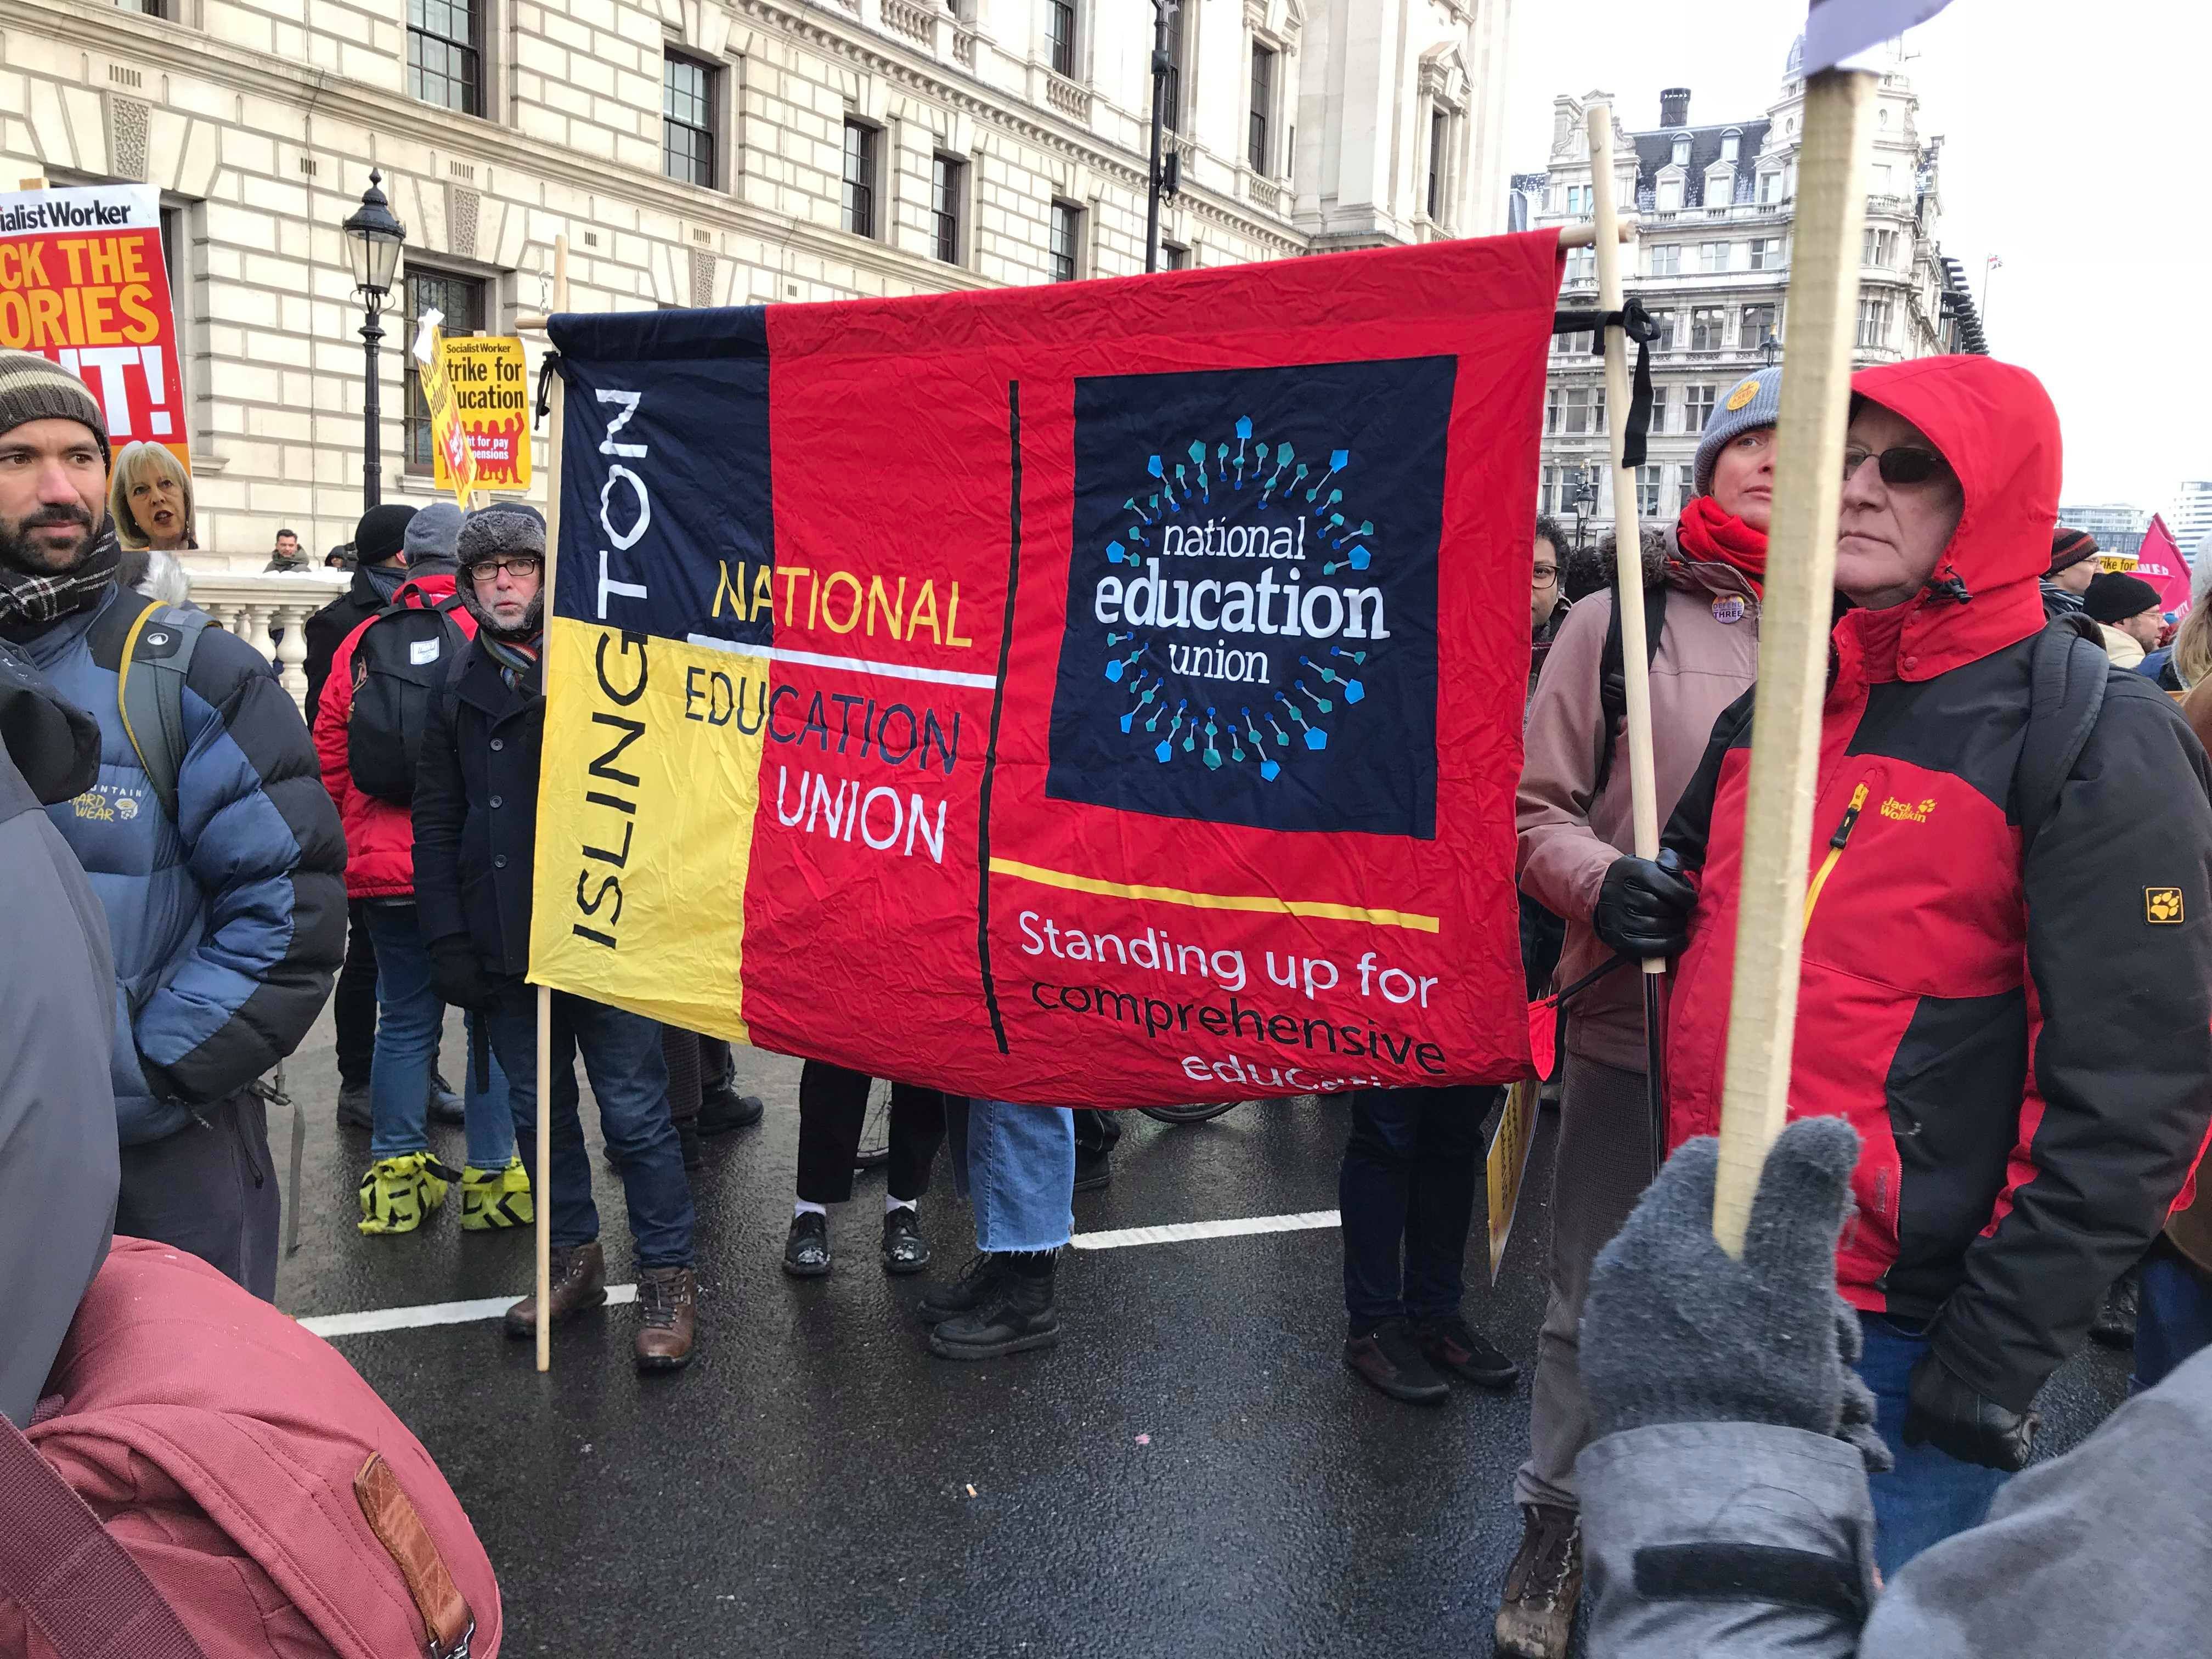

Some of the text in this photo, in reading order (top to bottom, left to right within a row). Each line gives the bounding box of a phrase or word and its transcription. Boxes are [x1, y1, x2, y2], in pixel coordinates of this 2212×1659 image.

[46, 200, 131, 227] Worker
[0, 236, 150, 289] CK THE
[0, 283, 159, 349] ORIES
[447, 343, 511, 354] Socialist Worker
[495, 356, 522, 381] for
[477, 435, 490, 447] for
[493, 438, 509, 450] pay
[1163, 516, 1307, 560] national
[2120, 558, 2135, 571] for
[712, 559, 973, 648] NATIONAL
[1095, 557, 1390, 640] education
[572, 388, 651, 950] ISLINGTON
[1169, 639, 1270, 684] union
[684, 665, 962, 775] EDUCATION
[76, 805, 115, 822] WEAR
[776, 766, 947, 864] UNION
[1883, 797, 1913, 812] Jack
[1019, 911, 1438, 1008] Standing up for
[1032, 981, 1446, 1074] comprehensive
